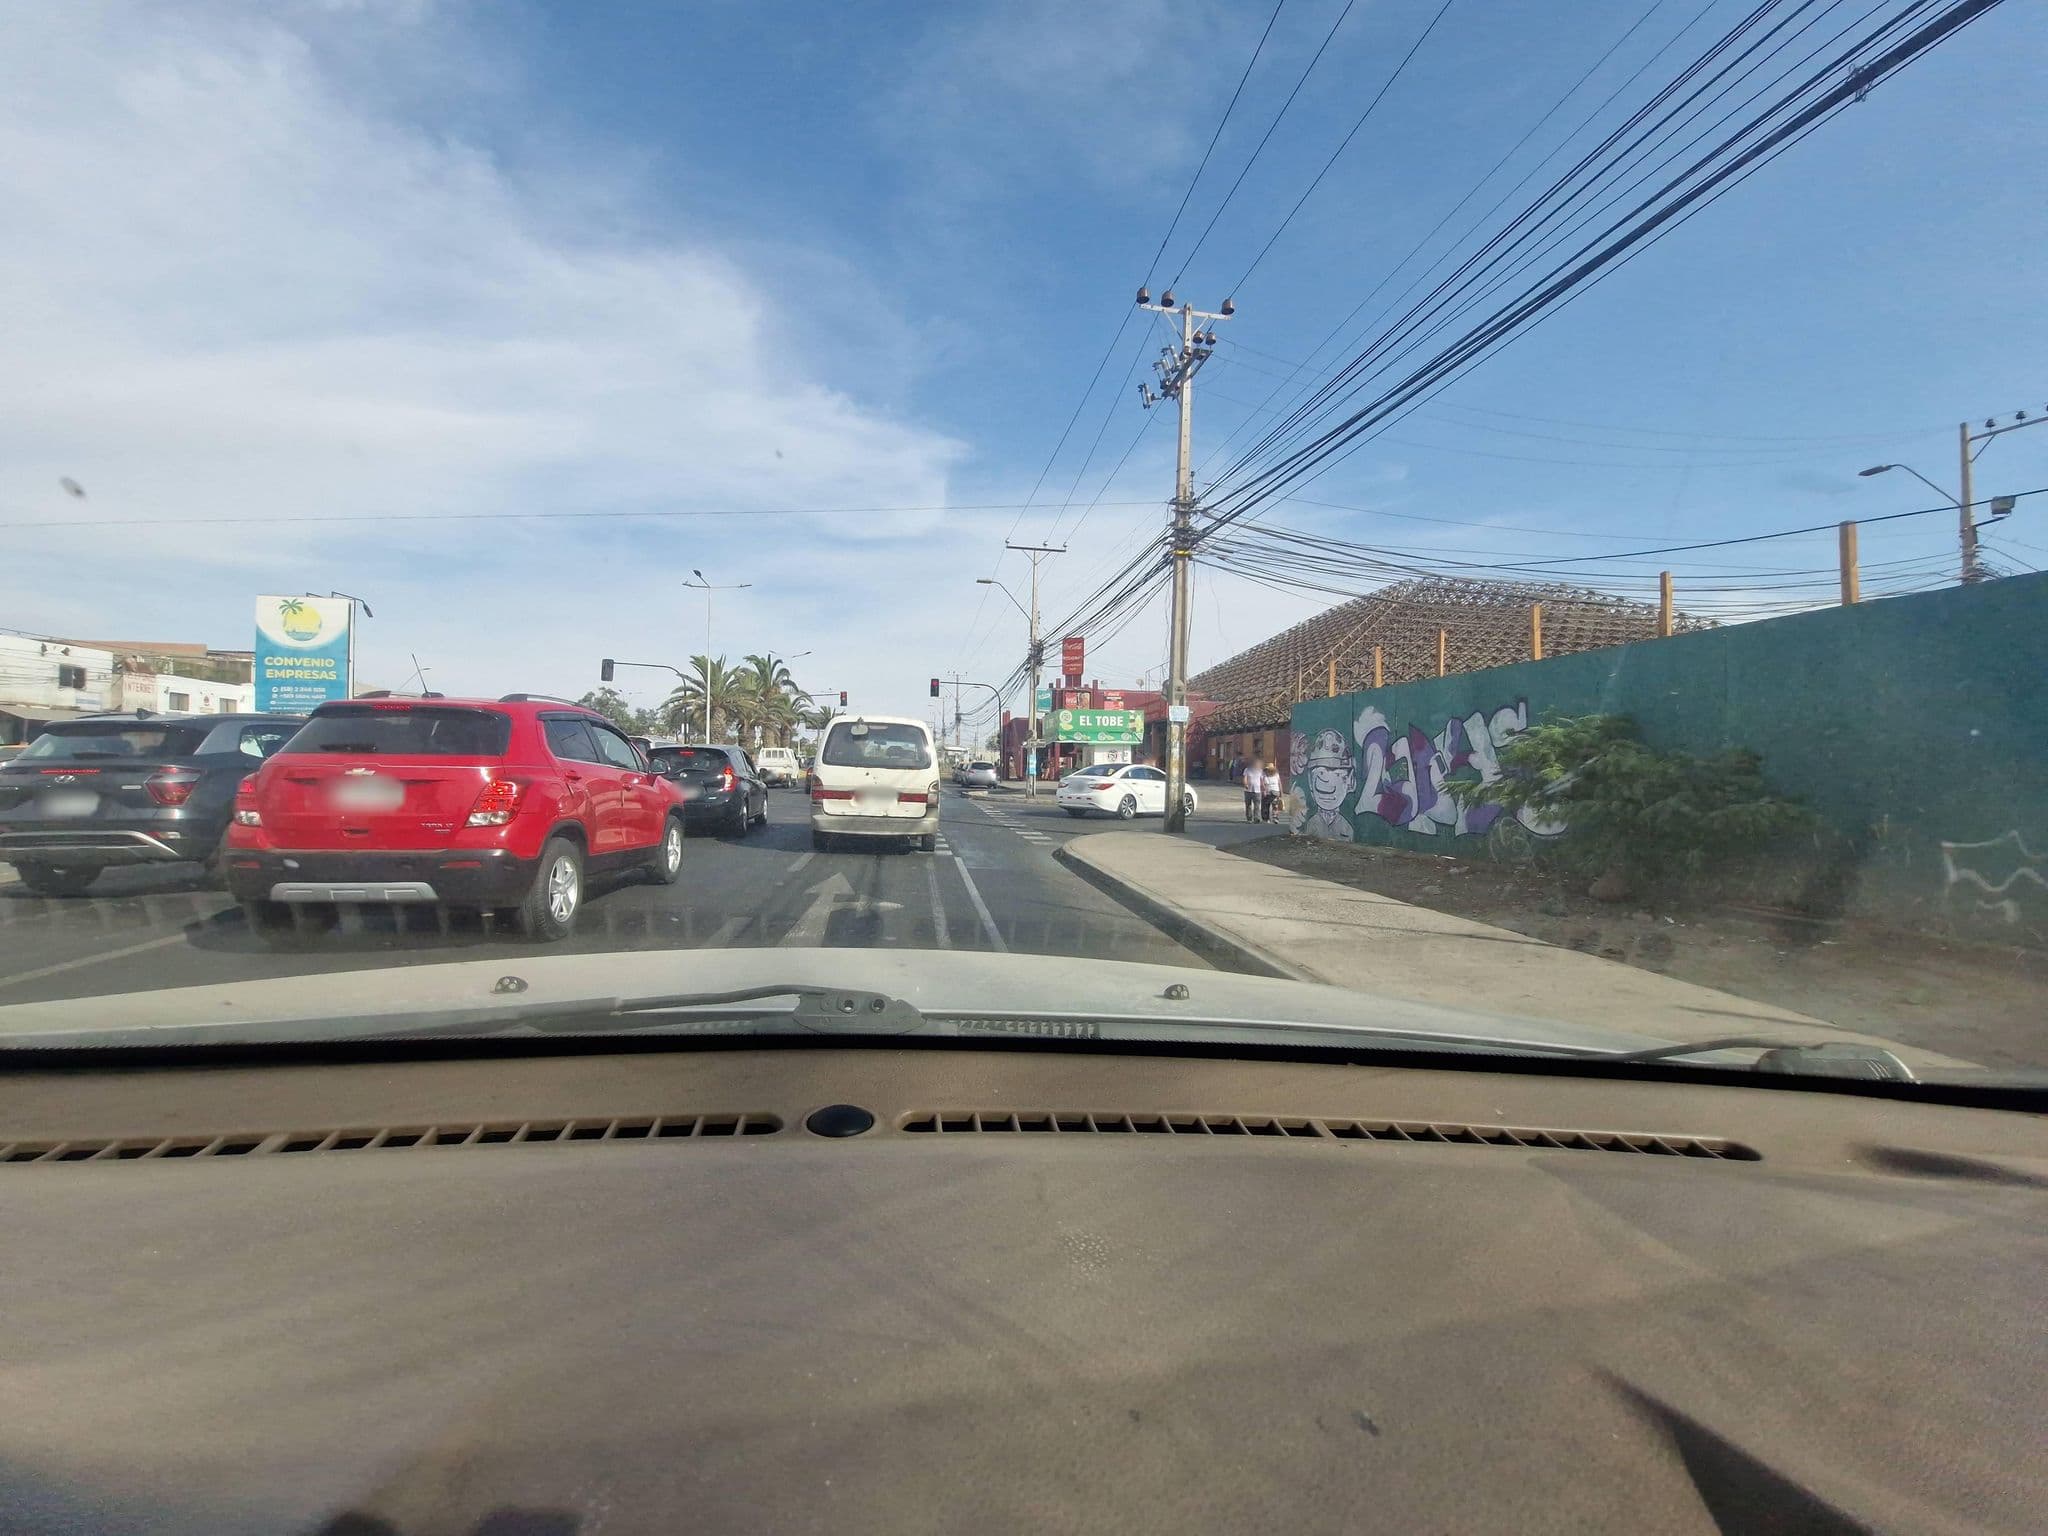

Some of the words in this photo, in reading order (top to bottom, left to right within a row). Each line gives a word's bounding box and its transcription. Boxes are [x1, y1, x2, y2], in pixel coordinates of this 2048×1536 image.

[264, 656, 335, 667] CONVENIO
[265, 668, 337, 680] EMPRESAS
[1080, 715, 1092, 726] EL
[1095, 715, 1124, 727] TOBE
